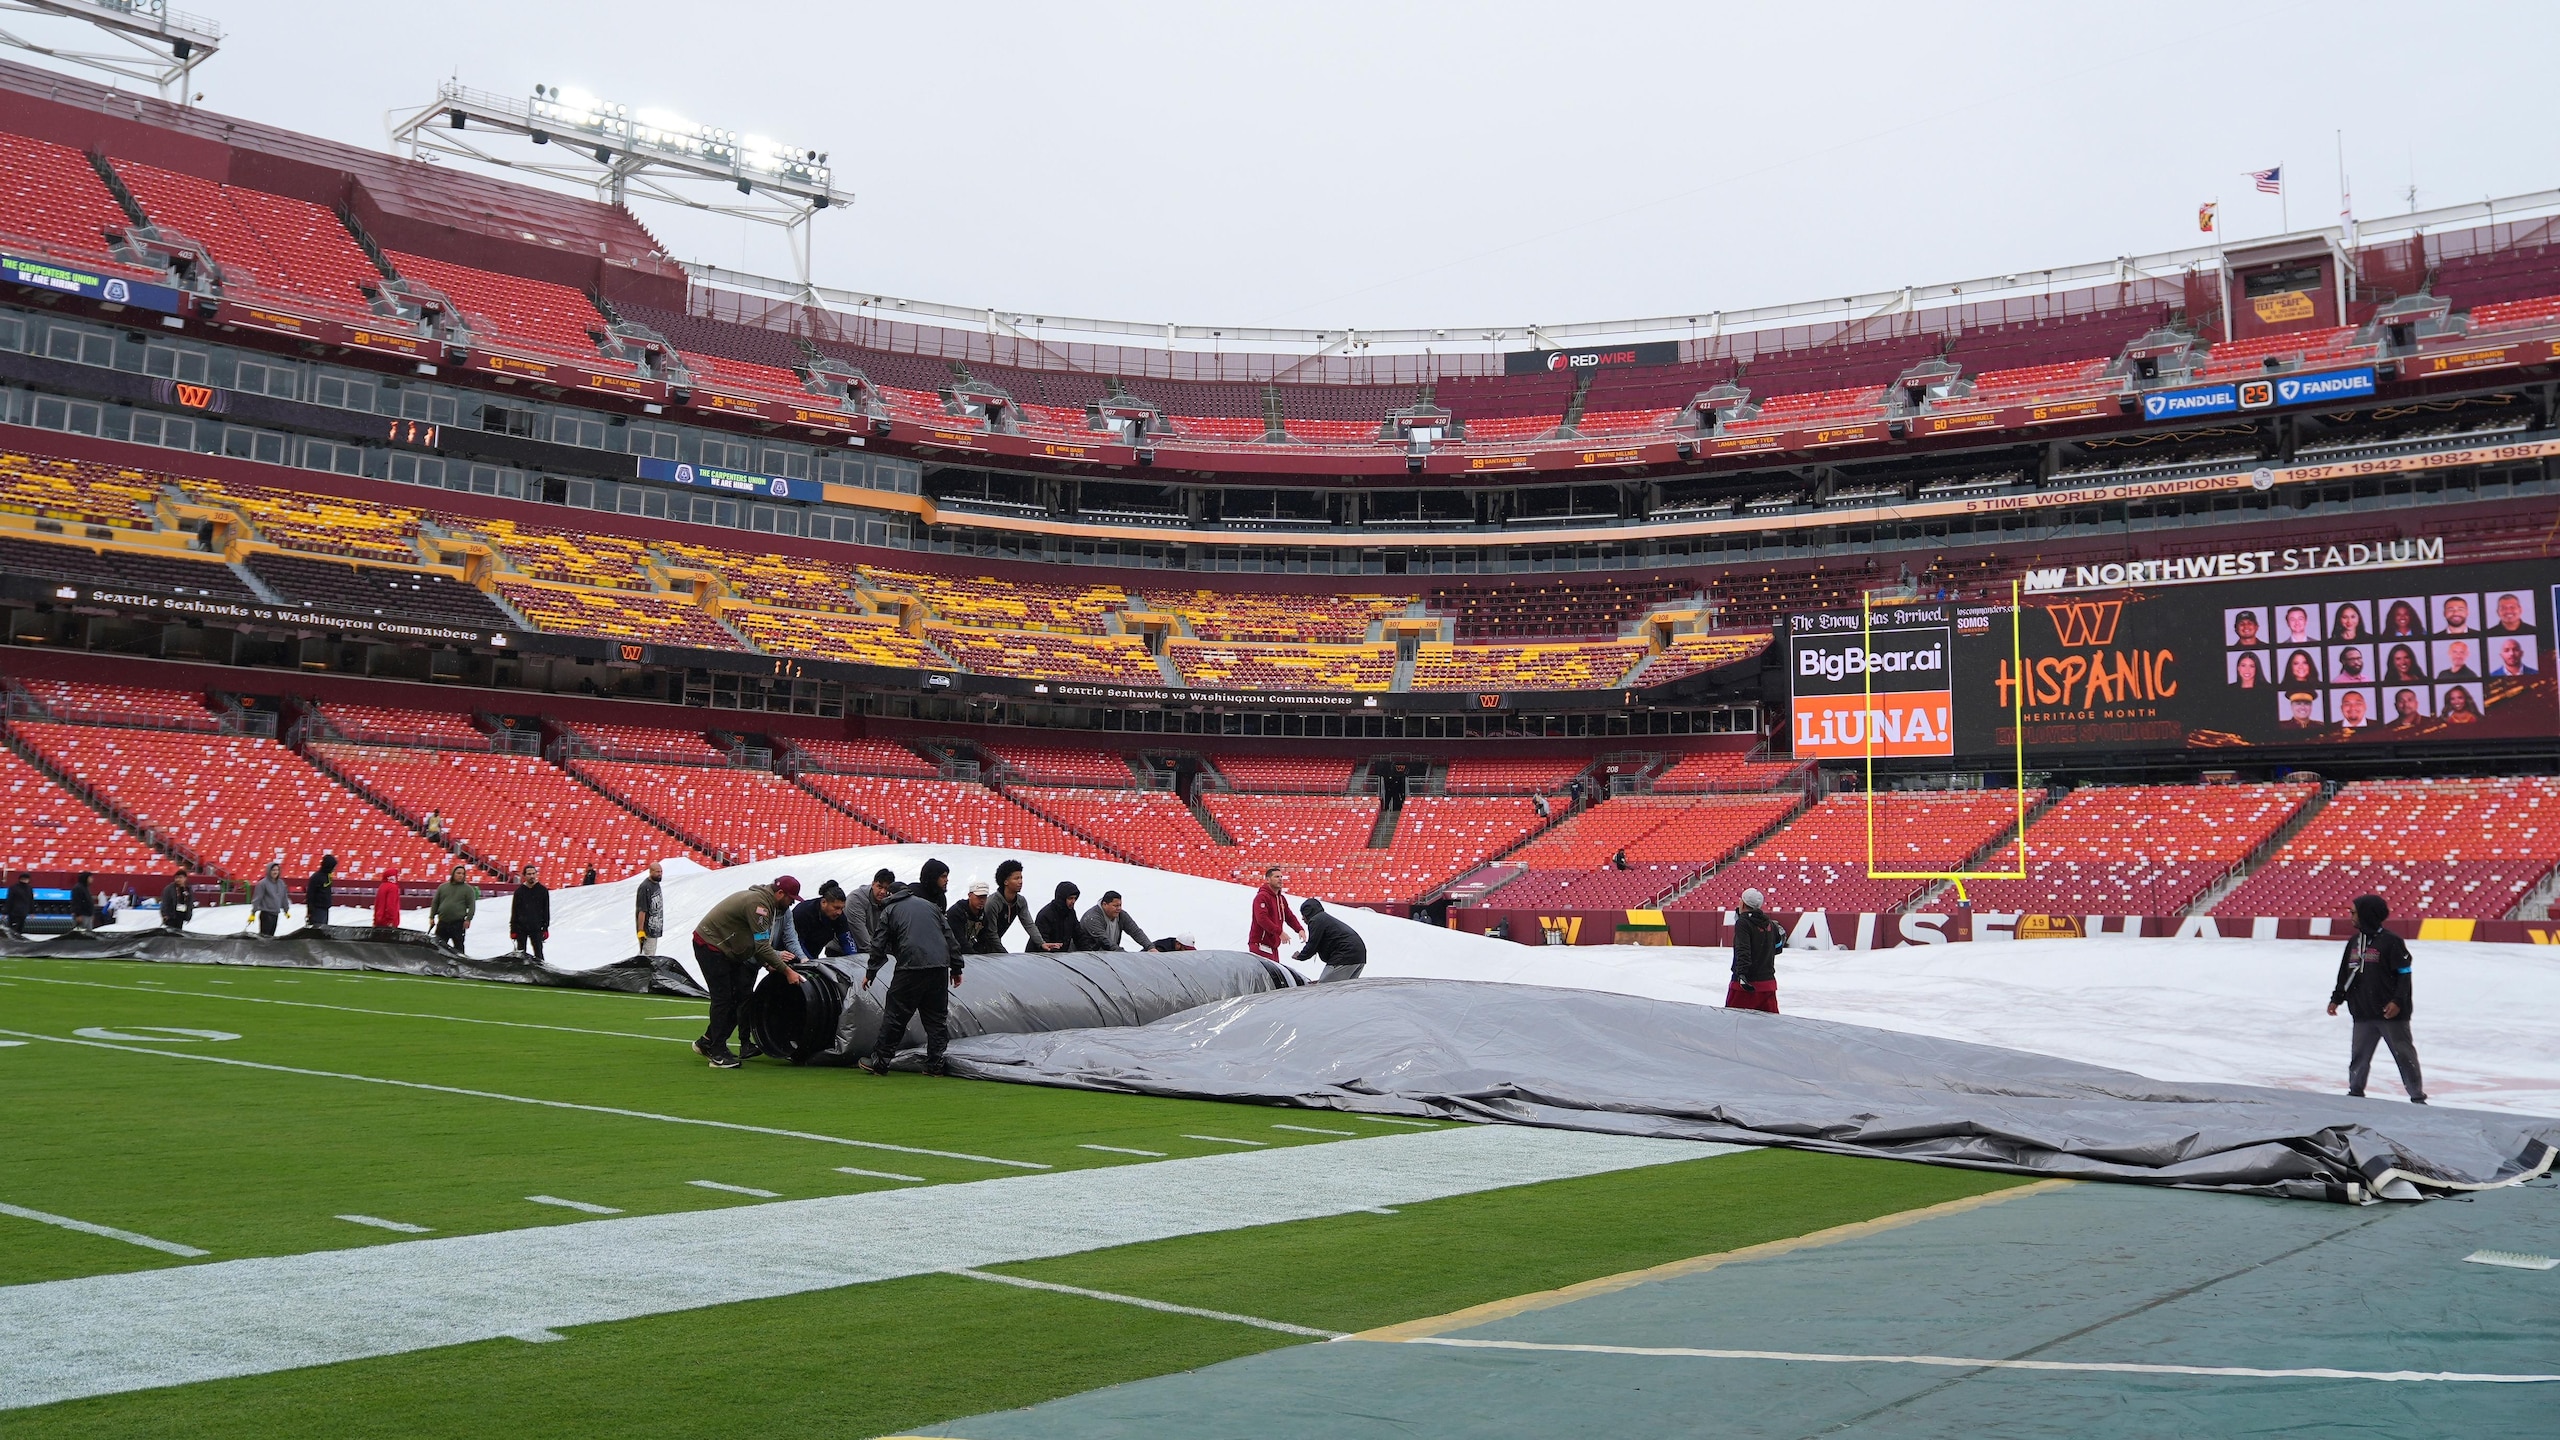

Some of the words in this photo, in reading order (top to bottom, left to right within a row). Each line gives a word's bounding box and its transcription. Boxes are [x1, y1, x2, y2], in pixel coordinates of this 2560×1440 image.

[178, 250, 193, 259] 403
[2, 258, 18, 269] THE
[18, 262, 72, 280] CARPENTERS
[72, 274, 99, 287] UNION
[18, 272, 31, 282] WE
[32, 274, 50, 286] ARE
[50, 278, 81, 292] HIRING
[425, 300, 439, 309] 404
[2256, 302, 2273, 311] TEXT
[354, 331, 370, 344] 20
[371, 334, 388, 343] CLIFF
[389, 337, 416, 348] BATTLES
[647, 343, 659, 351] 405
[1570, 351, 1636, 367] REDWIRE
[2132, 351, 2146, 359] 413
[489, 356, 503, 370] 43
[504, 359, 524, 369] LARRY
[524, 362, 546, 372] BROWN
[2433, 358, 2447, 370] 14
[591, 375, 603, 387] 17
[604, 378, 620, 387] BILLY
[2169, 393, 2234, 410] FANDUEL
[2244, 385, 2268, 403] 25
[2303, 375, 2372, 395] FANDUEL
[712, 396, 724, 408] 35
[725, 398, 736, 406] BILL
[736, 400, 758, 409] DUDLEY
[796, 410, 807, 421] 30
[809, 412, 825, 420] BRIAN
[825, 414, 850, 424] MITCHELL
[2033, 408, 2047, 420] 65
[2049, 405, 2066, 413] VINCE
[2067, 402, 2097, 411] PROMUTO
[1934, 418, 1947, 430] 60
[1966, 414, 1994, 423] SAMUELS
[935, 432, 953, 441] GEORGE
[954, 433, 972, 442] ALLEN
[1717, 440, 1736, 448] LAMAR
[1818, 431, 1830, 443] 47
[1045, 444, 1055, 455] 41
[1472, 459, 1485, 469] 89
[1583, 453, 1595, 463] 40
[2286, 466, 2332, 480] 1937
[2351, 459, 2403, 473] 1942
[2421, 452, 2473, 466] 1982
[2491, 444, 2544, 459] 1987
[699, 468, 710, 477] THE
[711, 470, 747, 482] CARPENTERS
[748, 476, 766, 485] UNION
[711, 478, 720, 486] WE
[721, 479, 732, 488] ARE
[733, 481, 753, 491] HIRING
[1966, 501, 1977, 511] 5
[1983, 498, 2029, 509] TIME
[2035, 489, 2106, 505] WORLD
[2113, 476, 2240, 498] CHAMPIONS
[2077, 551, 2275, 586] NORTHWEST
[2282, 537, 2444, 572] STADIUM
[92, 590, 158, 607] Seattle
[164, 598, 249, 617] Seahawks
[254, 608, 272, 619] vs
[277, 610, 374, 629] Washington
[378, 622, 478, 641] Commanders
[1791, 614, 1814, 631] The
[1819, 613, 1859, 630] Enemy
[1865, 611, 1889, 626] Has
[1957, 616, 1989, 628] SOMOS
[1799, 642, 1942, 681] BigBear.ai
[1994, 649, 2178, 709] HISPANIC
[1059, 685, 1103, 696] Seattle
[1107, 688, 1168, 699] Seahawks
[1172, 692, 1185, 700] vs
[1189, 692, 1264, 703] Washington
[1269, 695, 1352, 704] Commanders
[2024, 711, 2095, 722] HERITAGE
[2104, 708, 2156, 719] MONTH
[1797, 707, 1948, 745] LiUNA!
[2080, 721, 2182, 742] SPOTLIGHTS
[1606, 765, 1619, 773] 208
[2032, 918, 2045, 927] 19
